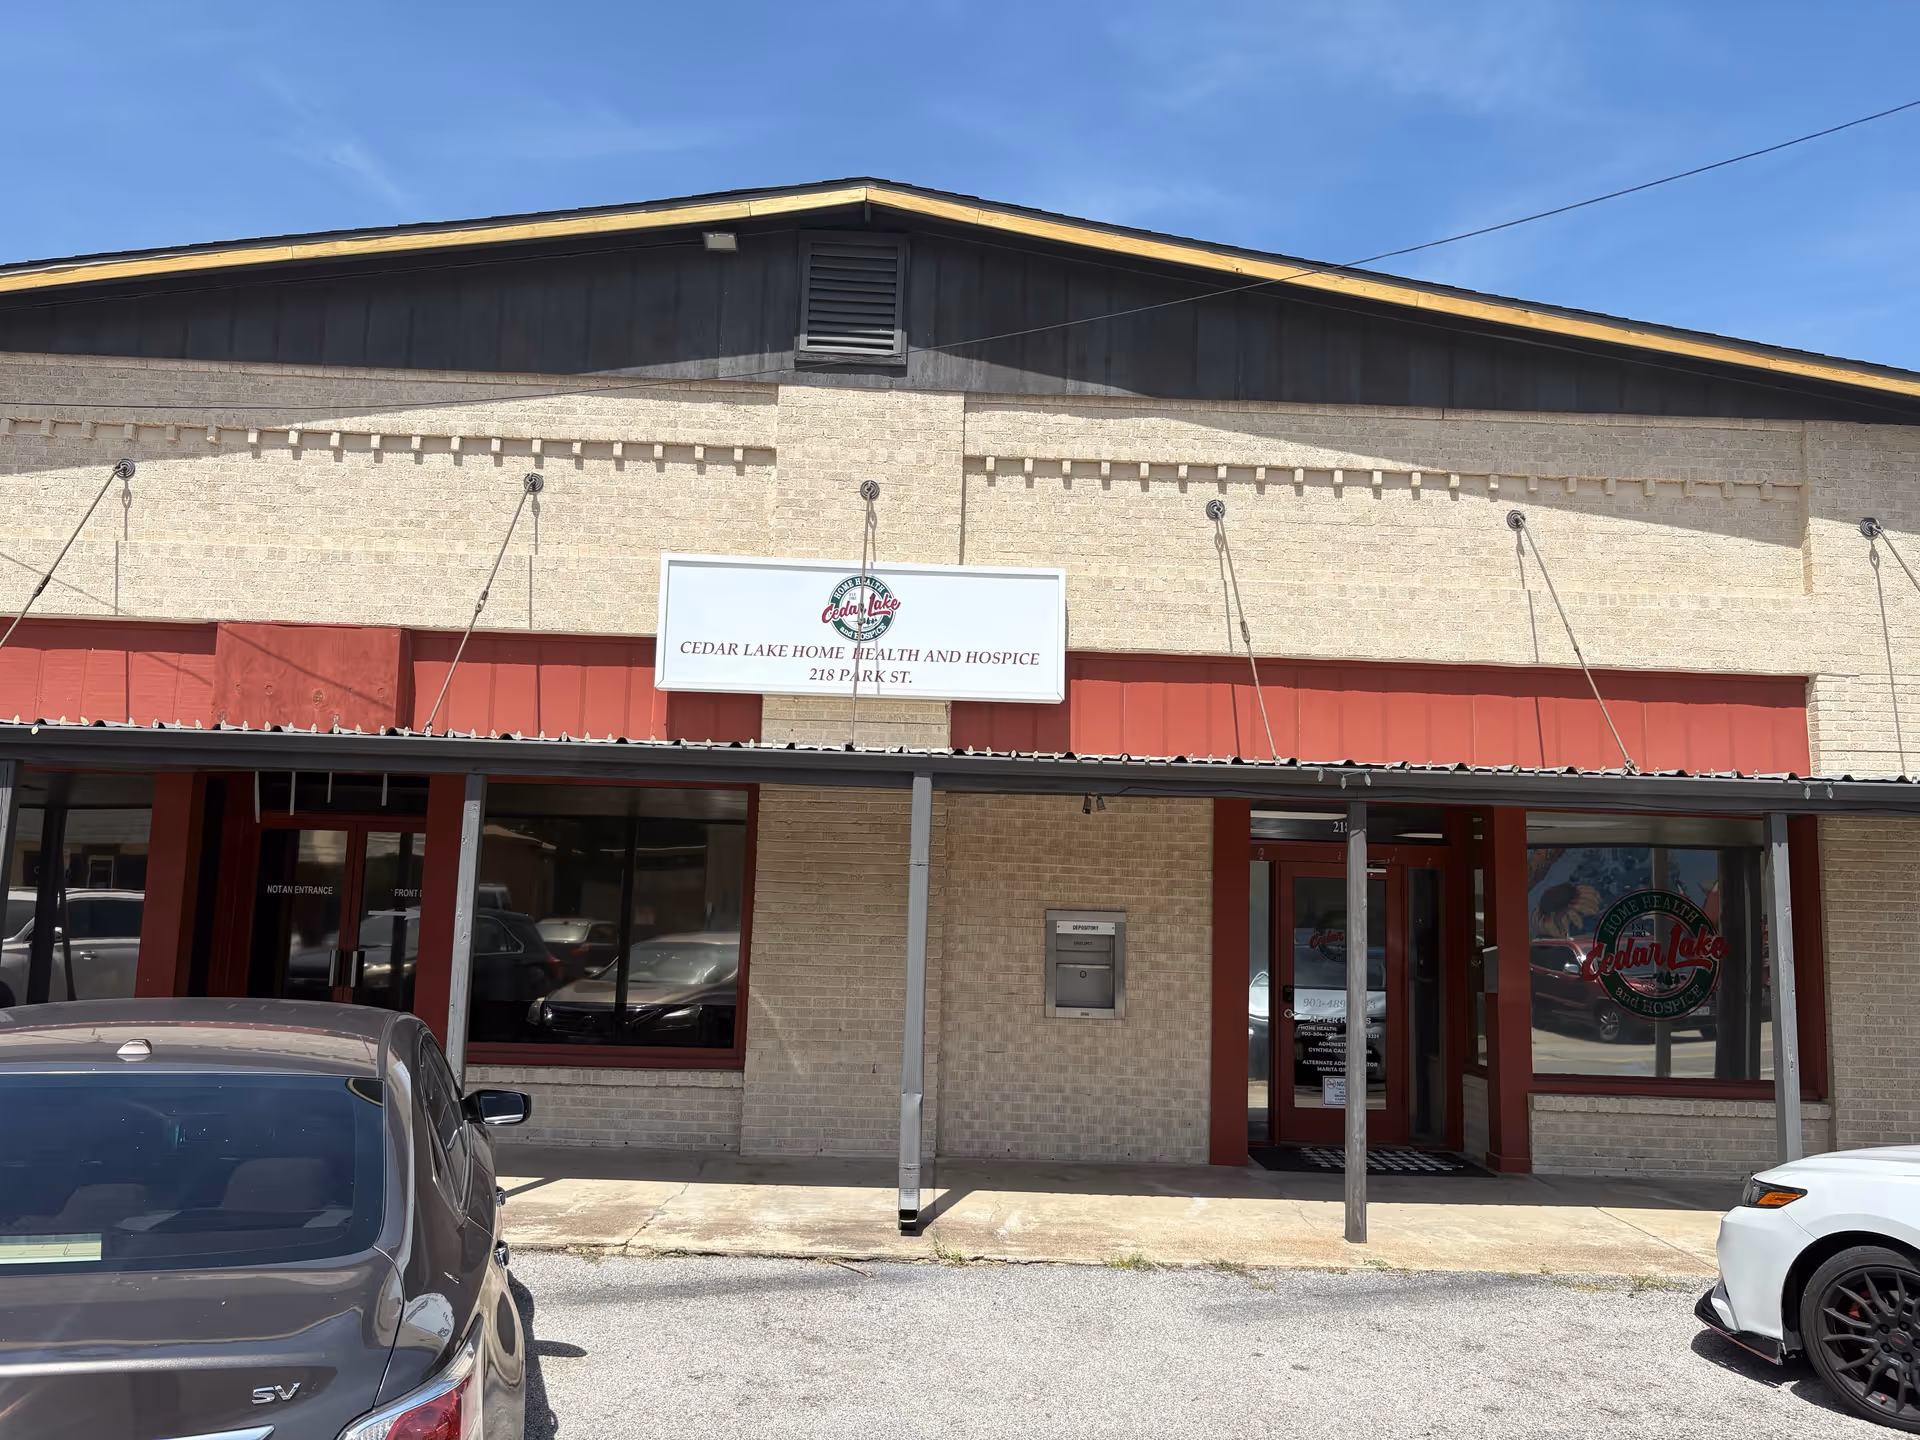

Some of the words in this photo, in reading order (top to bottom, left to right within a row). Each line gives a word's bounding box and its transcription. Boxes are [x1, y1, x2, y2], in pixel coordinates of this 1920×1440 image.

[833, 580, 854, 600] HOME
[867, 593, 901, 617] Lake
[840, 626, 853, 637] and
[680, 641, 738, 656] CEDAR
[743, 643, 789, 658] LAKE
[792, 645, 845, 660] HOME
[852, 648, 920, 662] HEALTH
[924, 650, 961, 663] AND
[965, 651, 1040, 665] HOSPICE
[809, 668, 834, 681] 218
[838, 669, 885, 683] PARK
[889, 671, 912, 684] ST.
[267, 884, 282, 894] NOT
[282, 885, 293, 894] AN
[294, 885, 333, 895] ENTRANCE
[394, 888, 418, 898] FRONT
[1603, 899, 1640, 936] HOME
[1641, 895, 1700, 923] HEALTH
[1581, 938, 1667, 981] Cedar
[1667, 923, 1731, 971] Lake
[1615, 986, 1639, 1009] and
[1641, 984, 1704, 1015] HOSPICE
[1309, 1015, 1338, 1024] AFTER
[251, 1382, 301, 1404] SV
